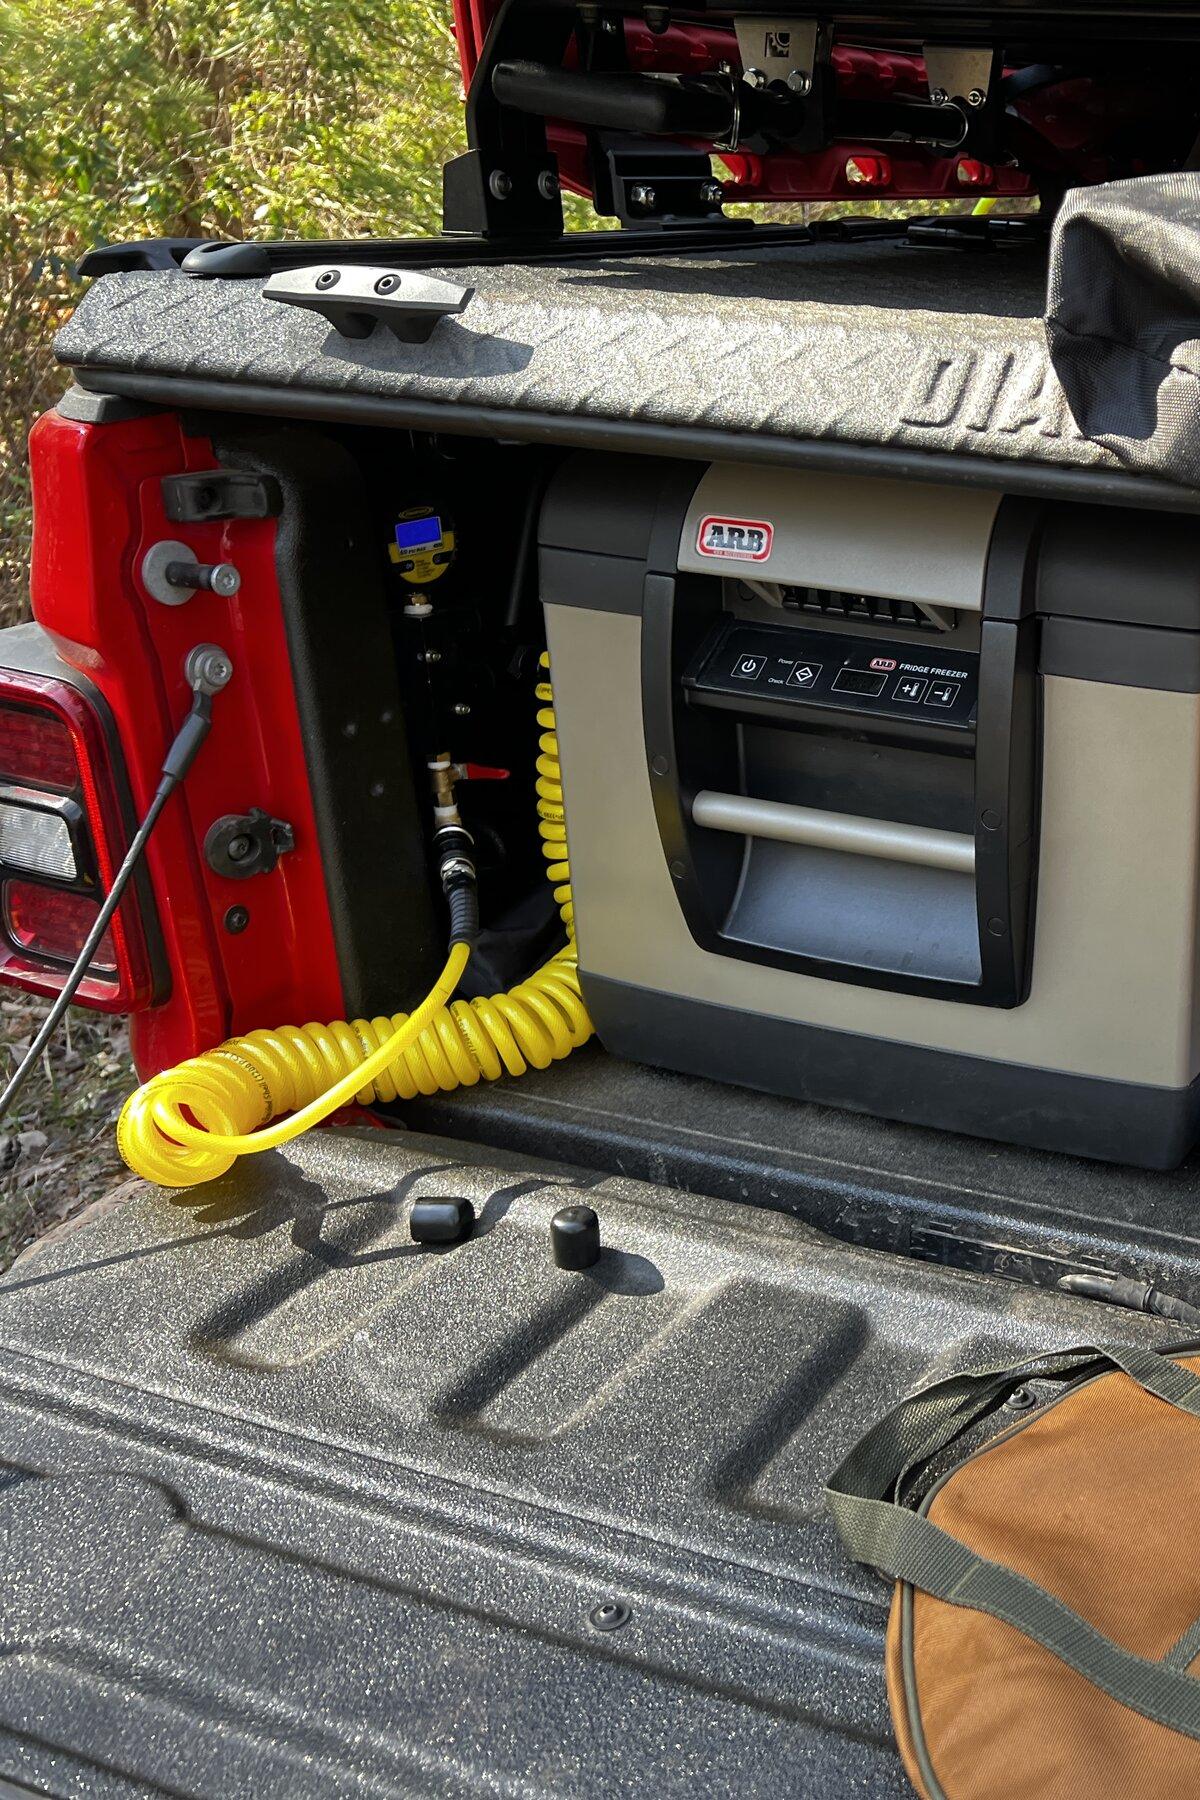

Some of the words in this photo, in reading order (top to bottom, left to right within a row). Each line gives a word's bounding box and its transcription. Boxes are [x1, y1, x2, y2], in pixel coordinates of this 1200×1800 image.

[706, 525, 763, 552] ARB
[899, 663, 929, 674] FRIDGE
[930, 667, 968, 679] FREEZER
